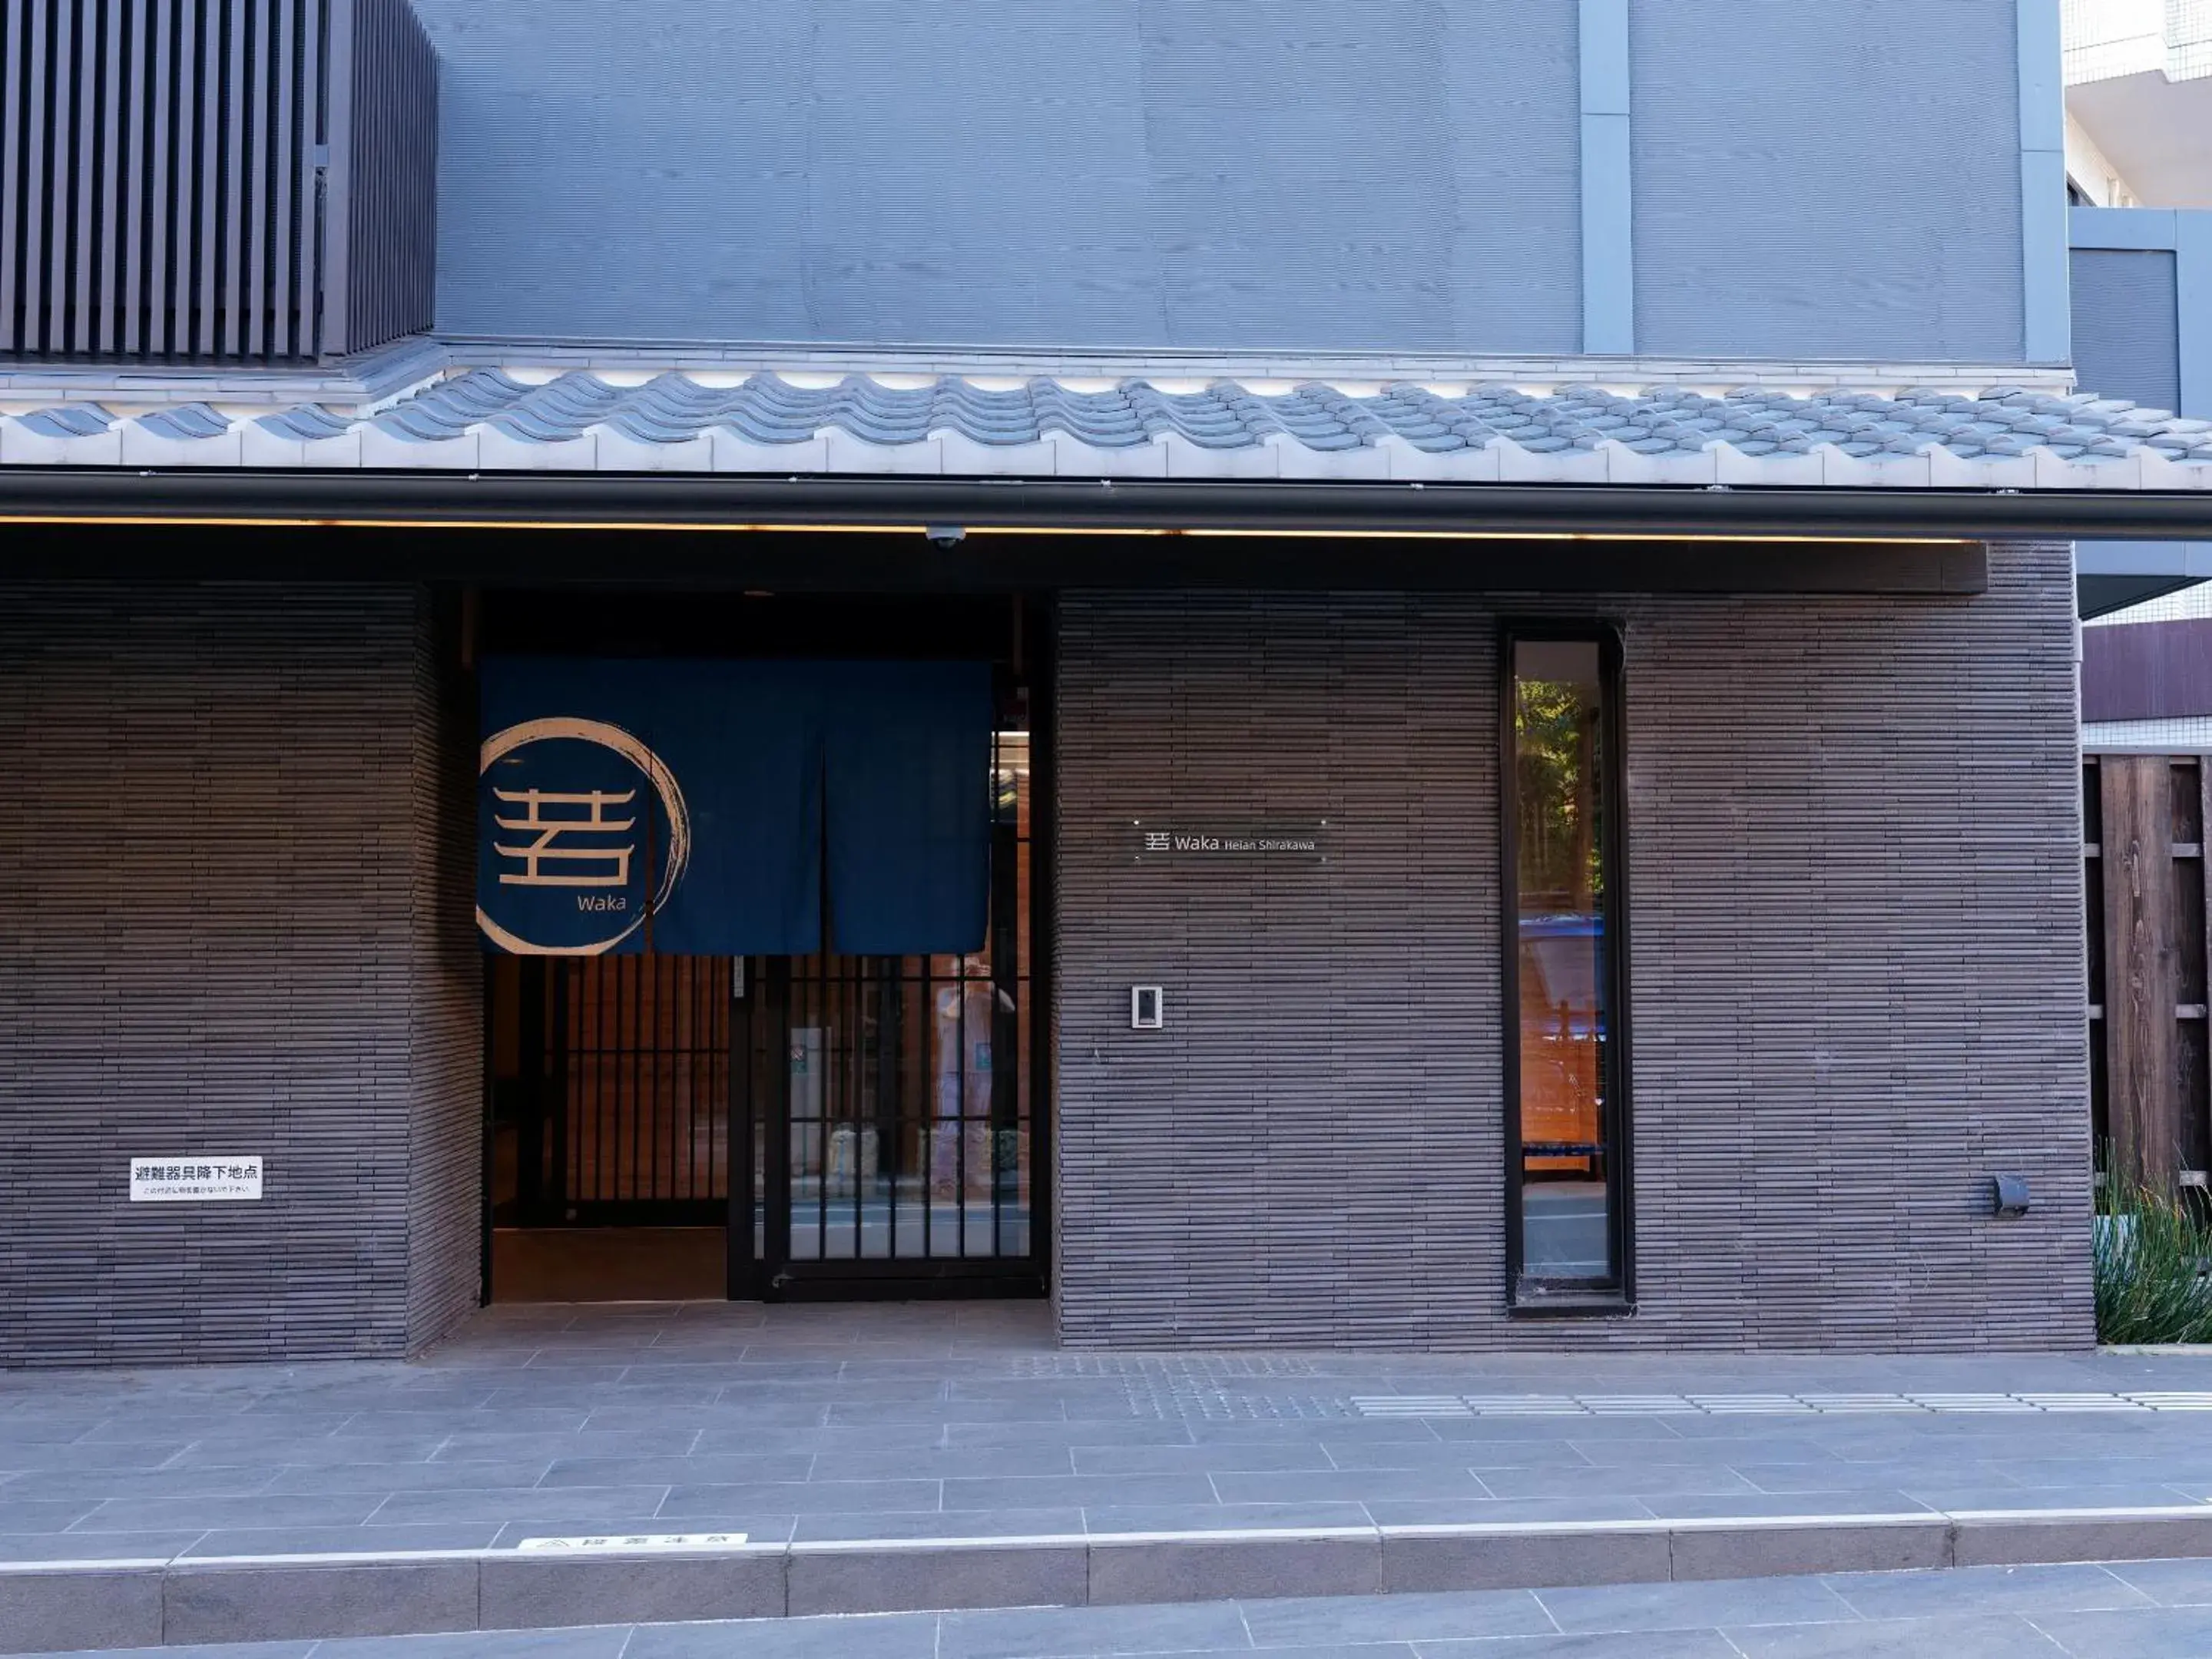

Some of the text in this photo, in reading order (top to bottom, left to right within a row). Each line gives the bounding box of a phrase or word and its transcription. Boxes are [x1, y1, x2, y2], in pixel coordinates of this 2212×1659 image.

[1174, 835, 1220, 851] Waka
[1224, 840, 1257, 851] Heian
[1259, 839, 1315, 851] Shirakawa
[577, 895, 627, 912] Waka
[135, 1164, 258, 1181] 避難器具降下地点
